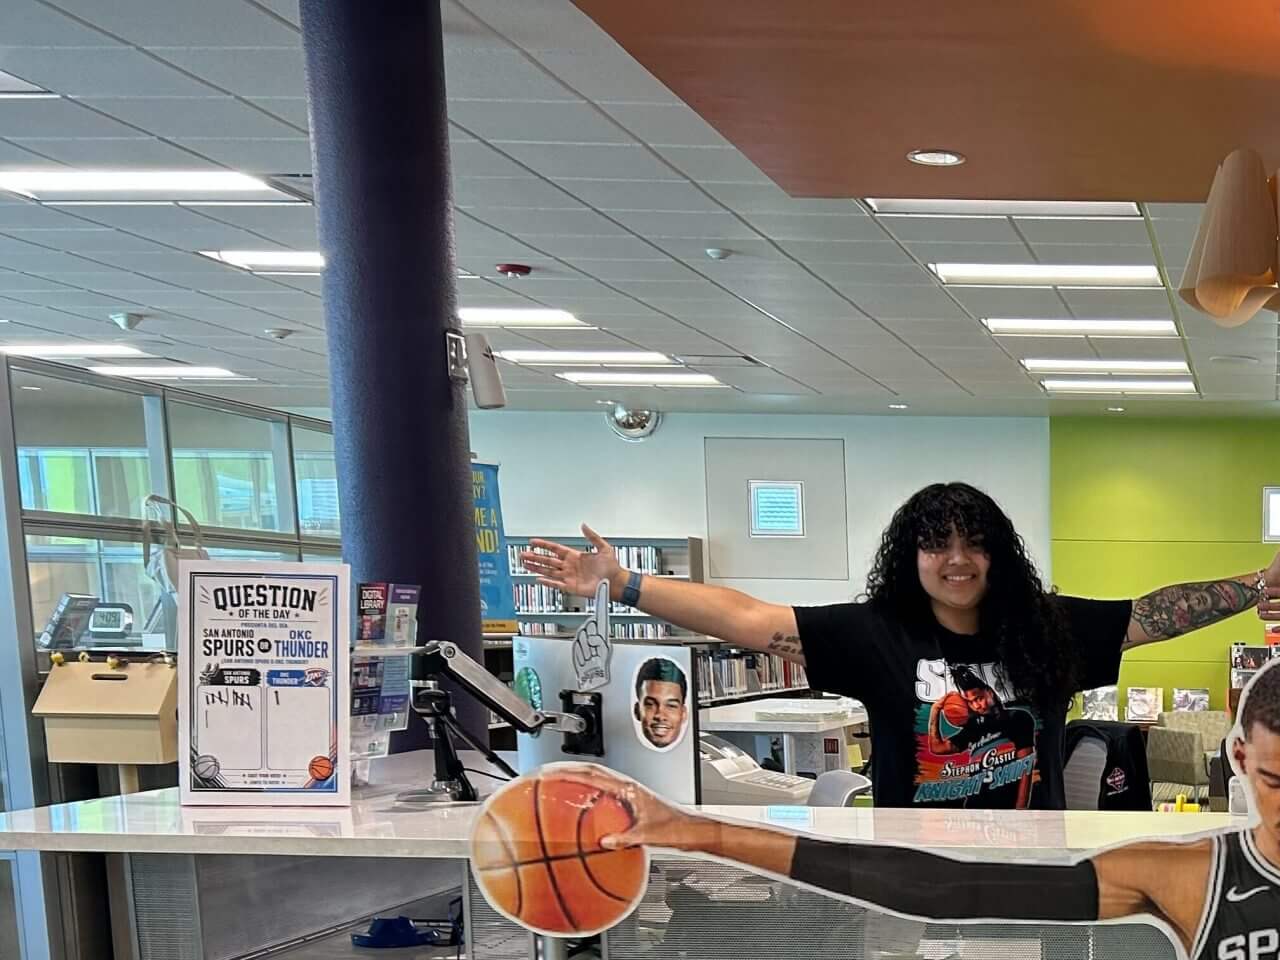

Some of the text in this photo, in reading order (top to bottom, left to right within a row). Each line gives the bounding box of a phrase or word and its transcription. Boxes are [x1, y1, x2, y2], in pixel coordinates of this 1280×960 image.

[213, 585, 317, 612] QUESTION
[360, 599, 386, 610] LIBRARY
[238, 609, 291, 620] OF THE DAY
[203, 628, 255, 639] SAN ANTONIO
[289, 630, 312, 640] OKC
[202, 639, 255, 657] SPURS
[259, 641, 270, 651] OR
[274, 640, 329, 659] THUNDER
[224, 675, 250, 685] SPURS
[912, 773, 983, 803] KNIGHT
